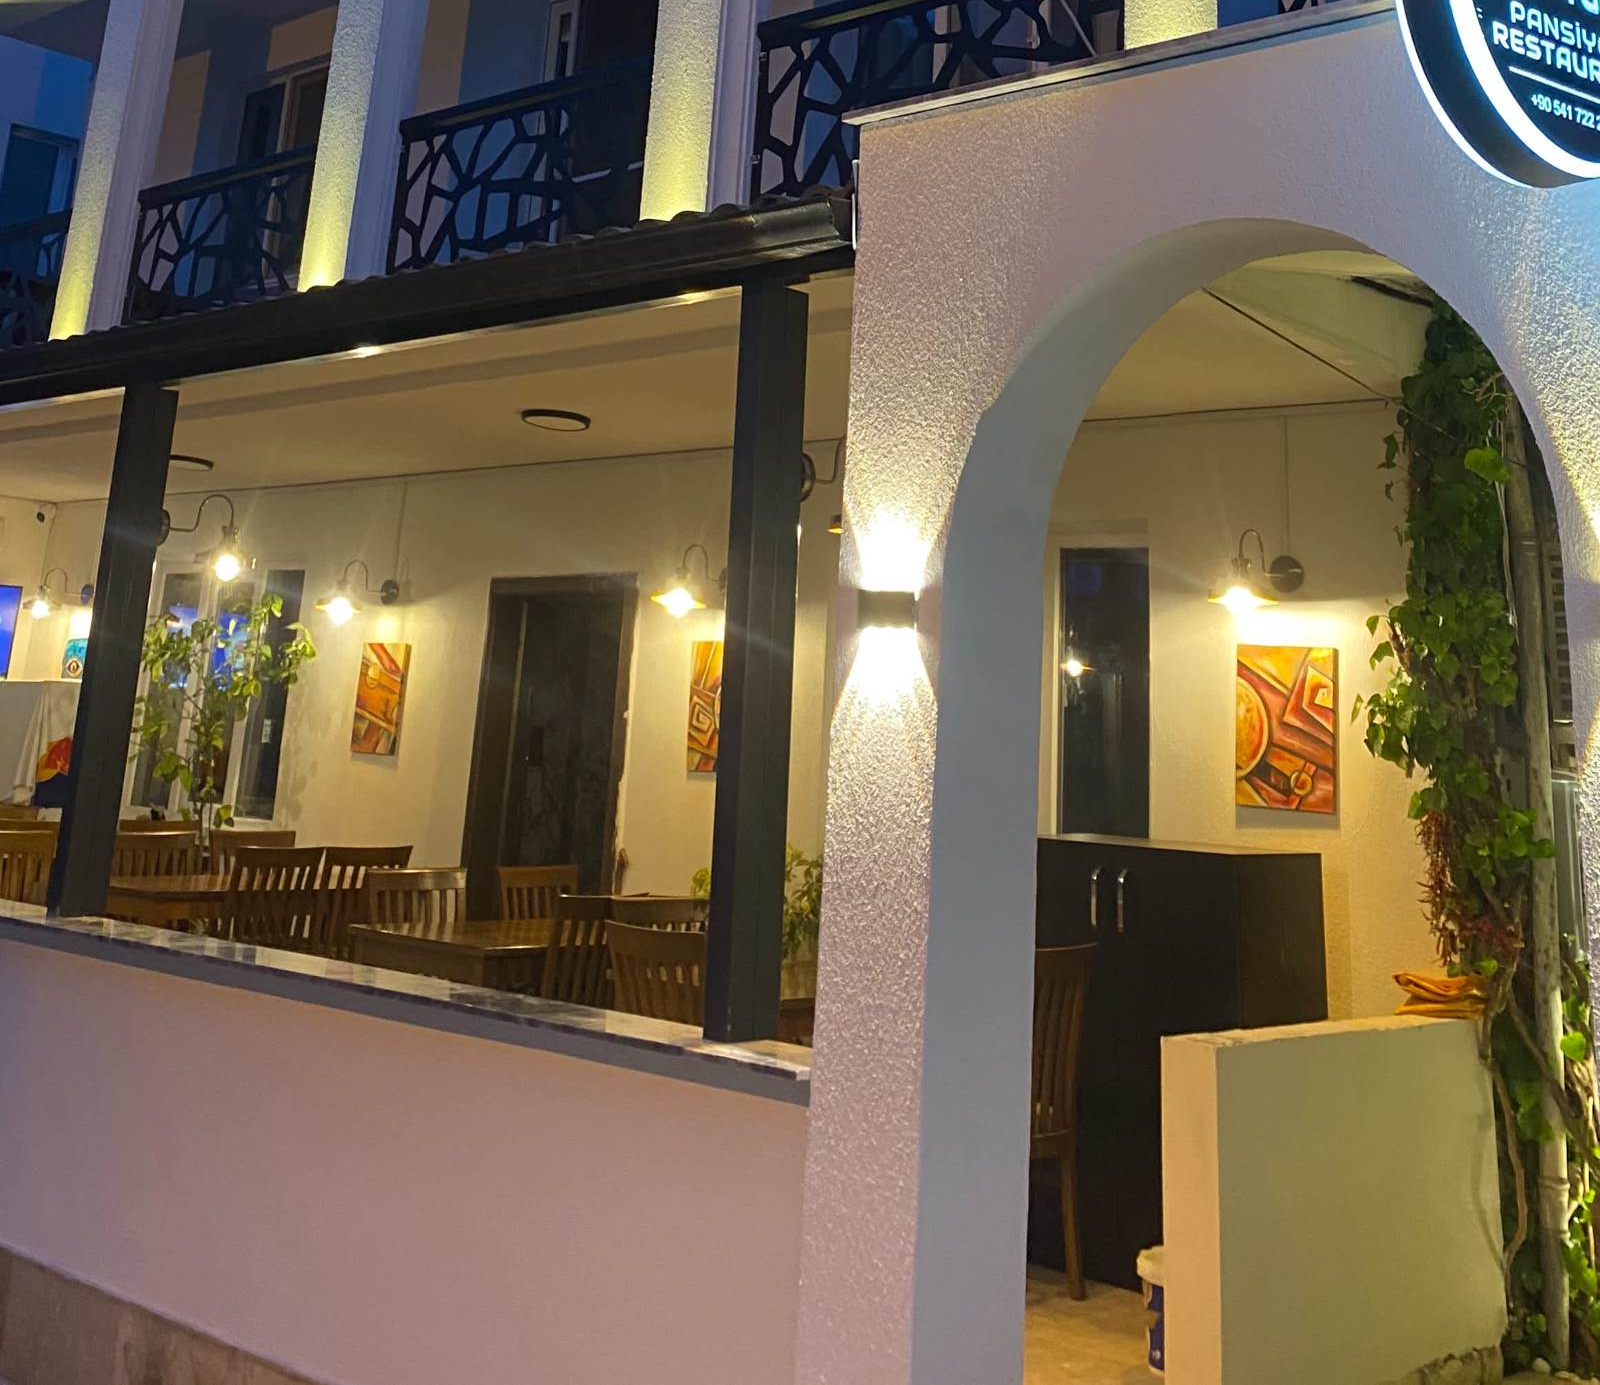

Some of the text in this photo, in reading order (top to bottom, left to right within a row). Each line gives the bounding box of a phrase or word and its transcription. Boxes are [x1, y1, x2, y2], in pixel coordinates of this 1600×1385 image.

[1492, 20, 1600, 85] RESTAUR
[1510, 0, 1600, 55] PANSİY
[1531, 94, 1552, 113] +90
[1553, 99, 1573, 121] 541
